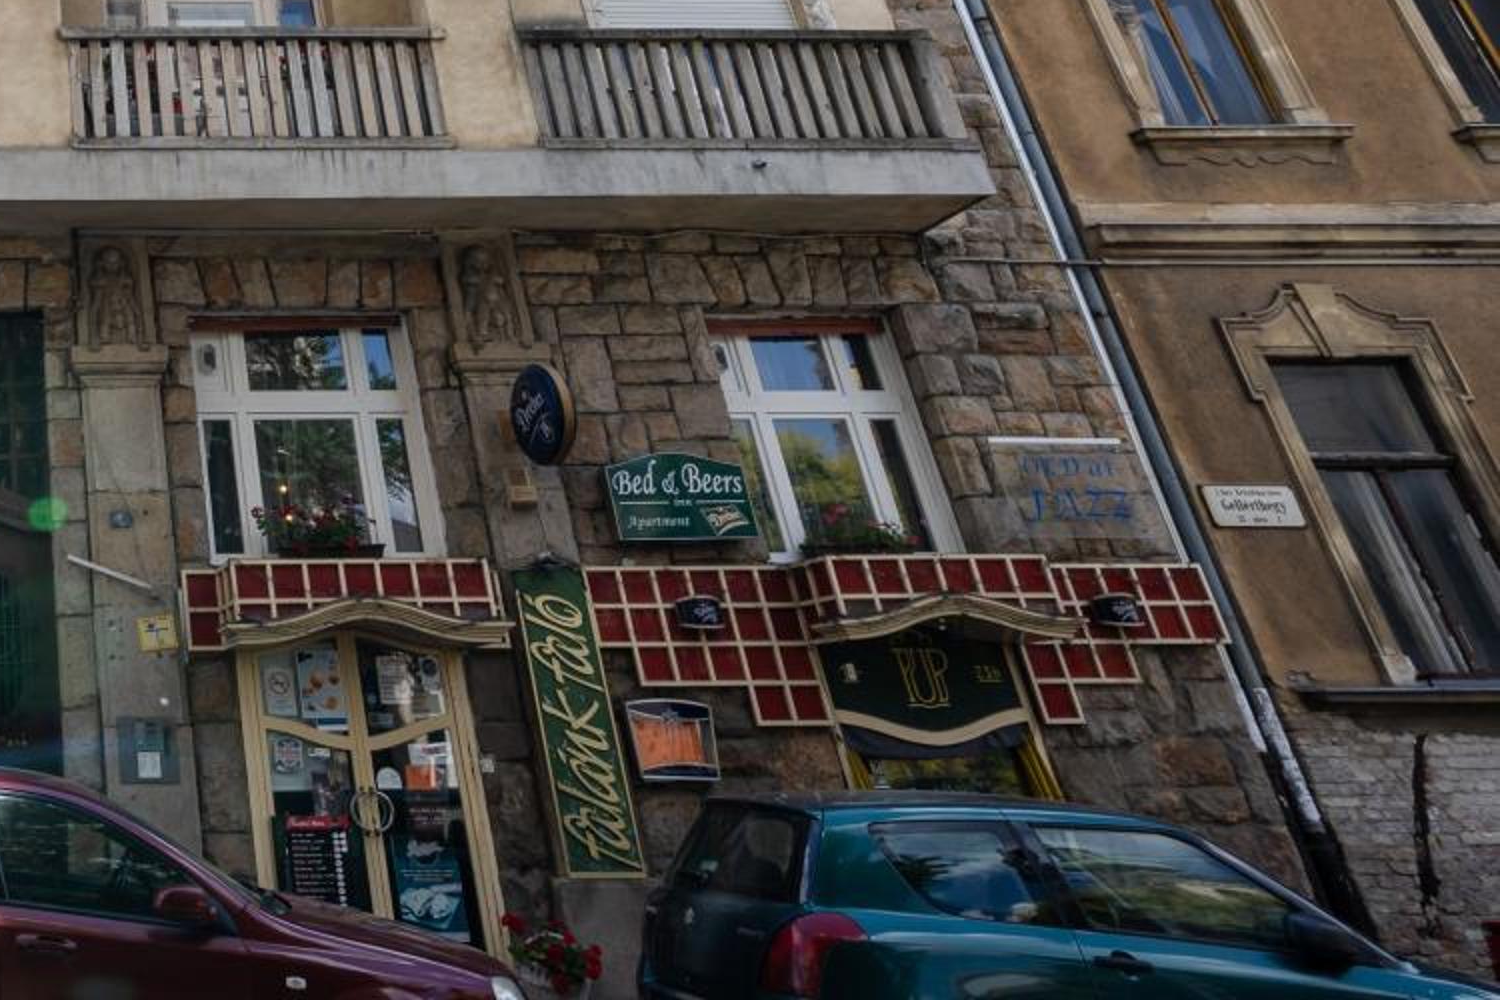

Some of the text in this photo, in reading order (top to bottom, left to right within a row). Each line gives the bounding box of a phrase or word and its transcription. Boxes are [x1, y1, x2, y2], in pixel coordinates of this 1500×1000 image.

[612, 459, 743, 495] Bed & Beers
